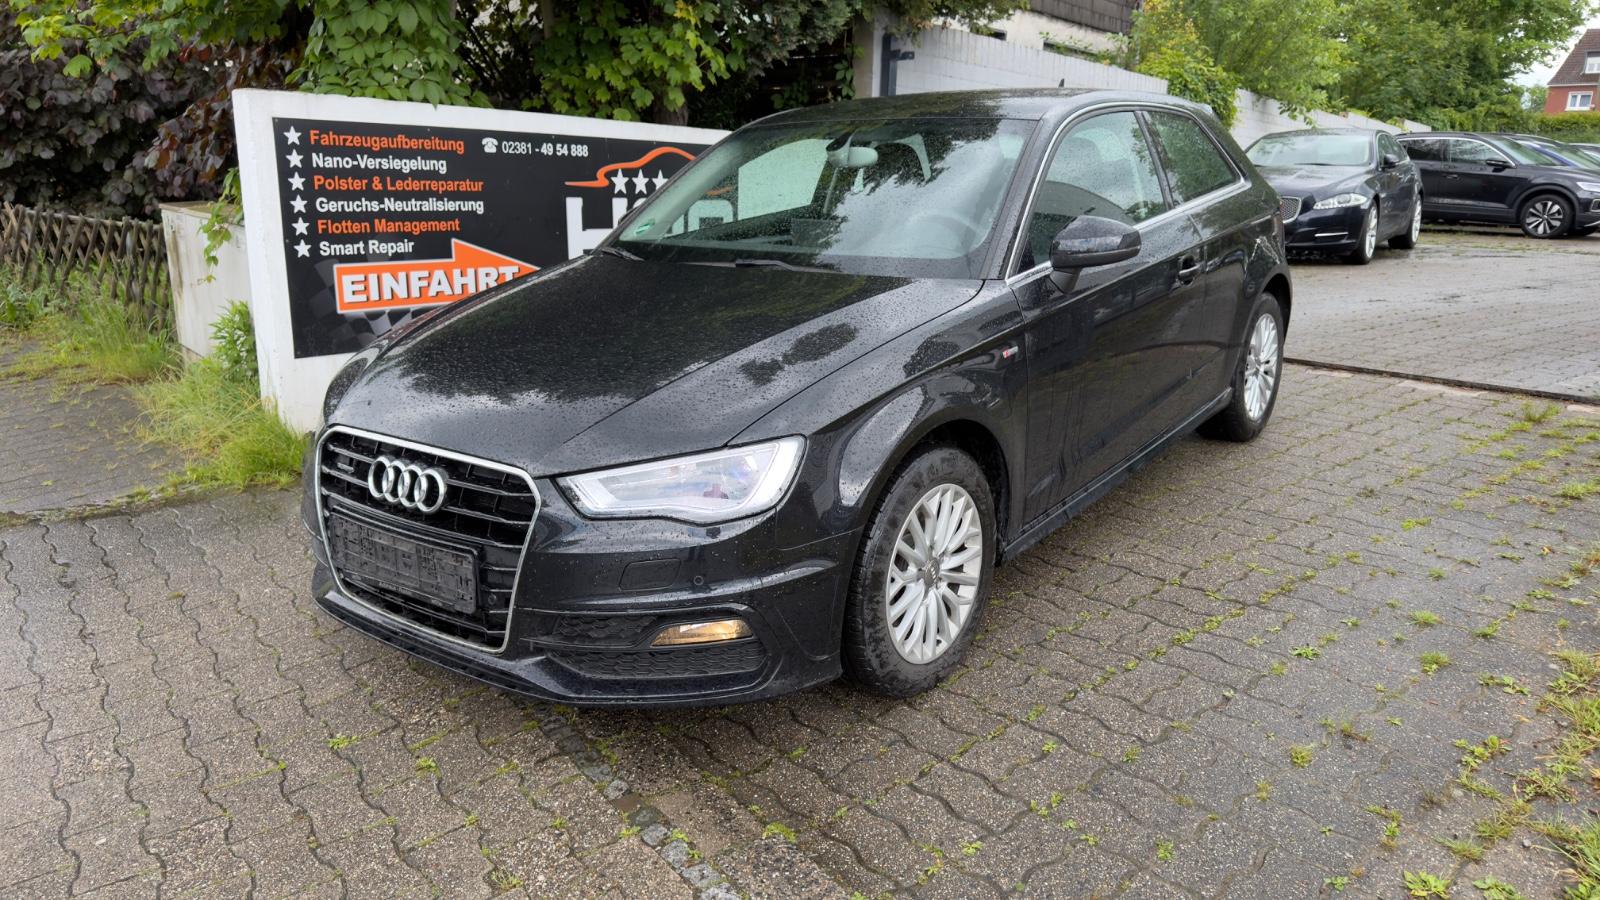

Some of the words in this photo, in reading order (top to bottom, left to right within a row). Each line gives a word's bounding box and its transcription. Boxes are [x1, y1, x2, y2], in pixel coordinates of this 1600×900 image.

[309, 130, 465, 154] Fahrzeugaufbereitung
[501, 141, 532, 155] 02381
[540, 142, 553, 156] 49
[556, 143, 568, 156] 54
[570, 144, 589, 157] 888
[311, 152, 447, 174] Nano-Versiegelung
[313, 175, 368, 191] Polster
[372, 176, 383, 191] &
[386, 177, 484, 194] Lederreparatur
[315, 197, 484, 215] Geruchs-Neutralisierung
[317, 219, 370, 234] Flotten
[374, 218, 460, 235] Management
[319, 241, 364, 256] Smart
[368, 239, 414, 256] Repair
